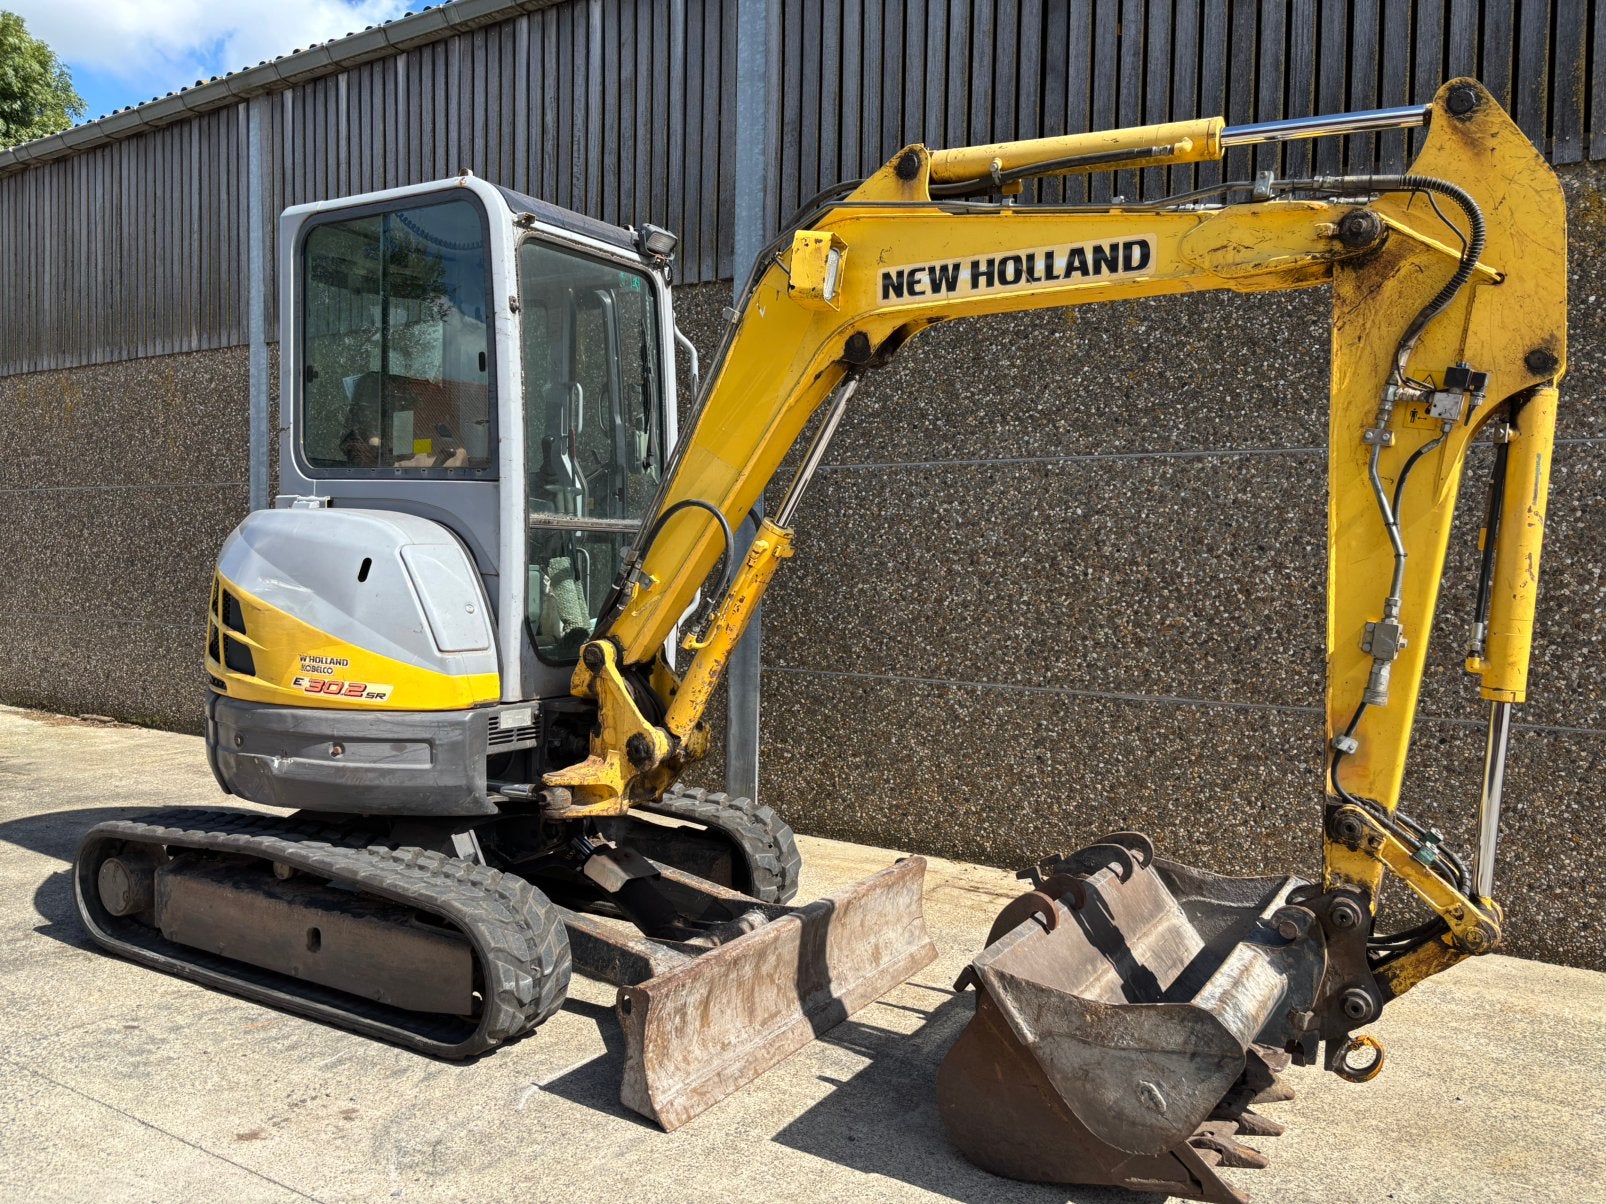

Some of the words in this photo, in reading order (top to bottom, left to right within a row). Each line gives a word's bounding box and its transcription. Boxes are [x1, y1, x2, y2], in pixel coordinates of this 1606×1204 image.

[881, 262, 961, 300] NEW
[970, 238, 1151, 290] HOLLAND
[308, 655, 348, 666] HOLLAND
[305, 678, 367, 698] 30.2
